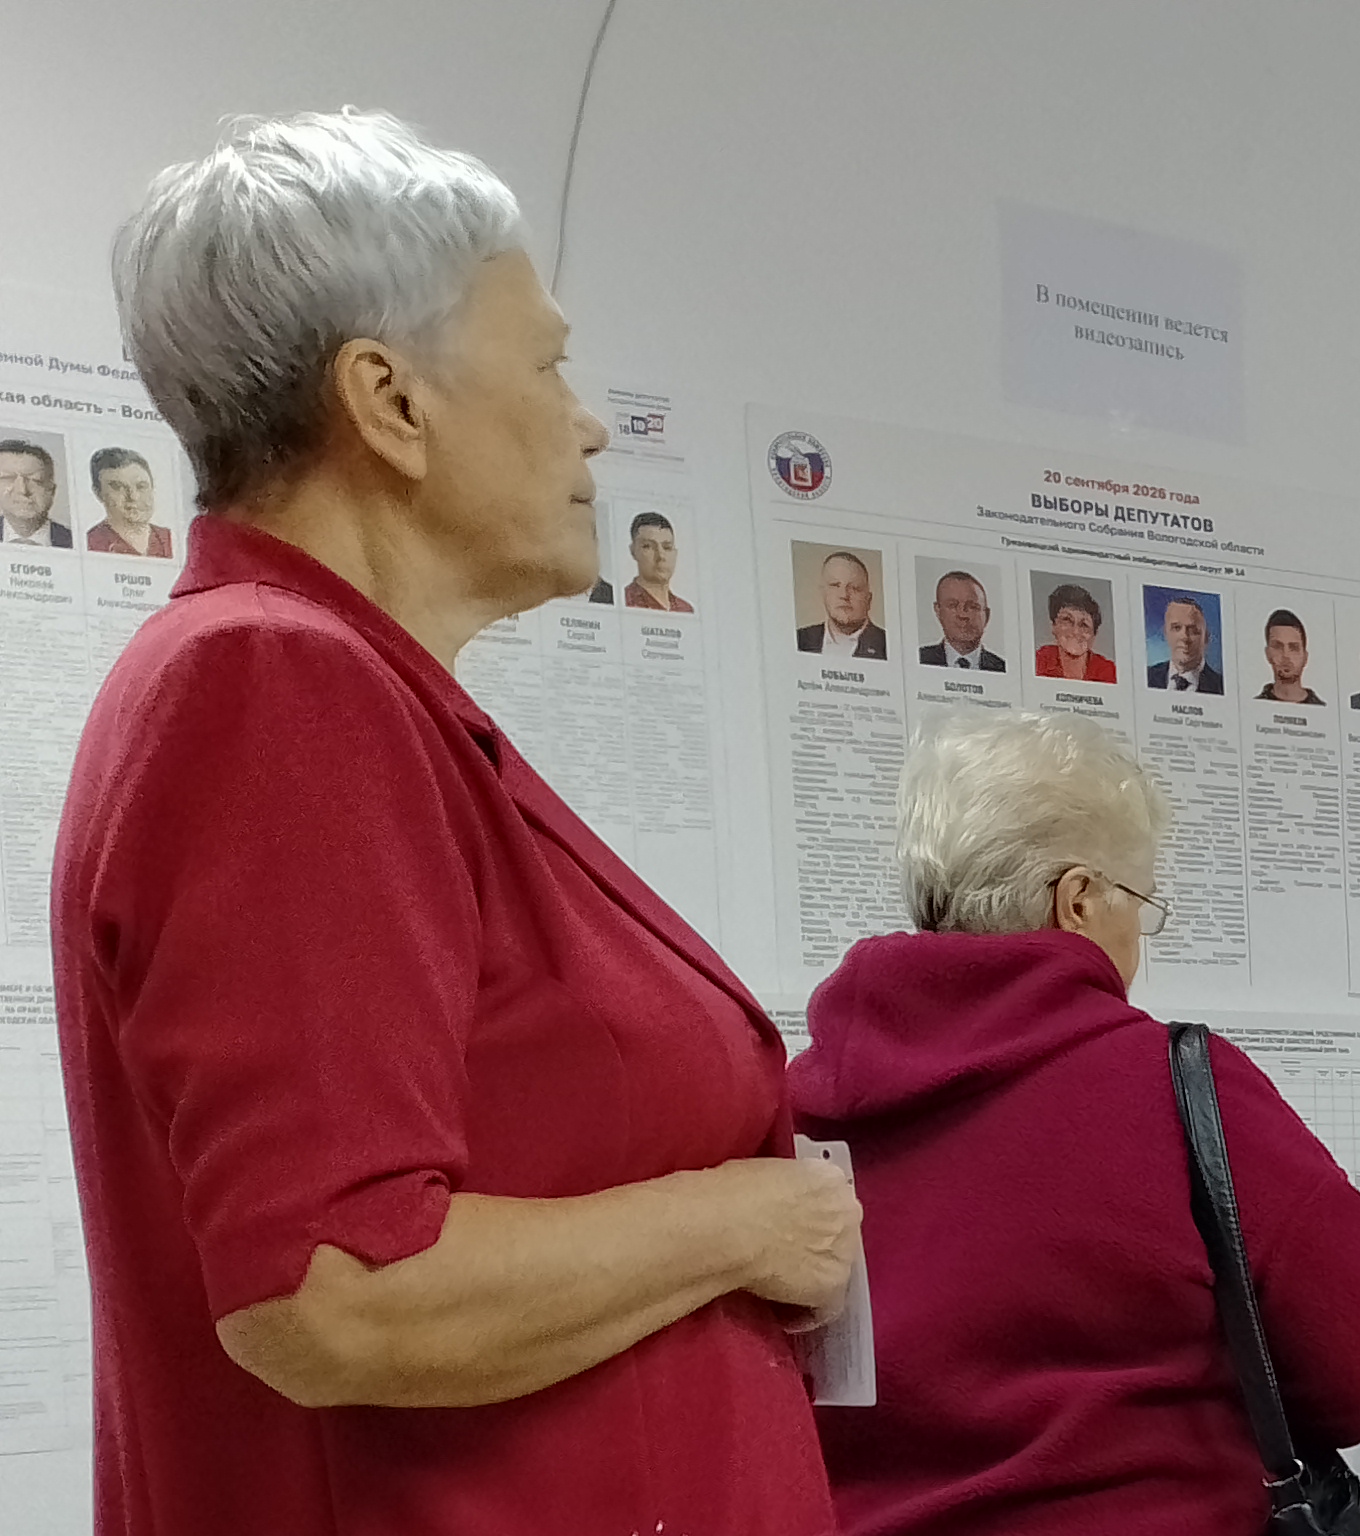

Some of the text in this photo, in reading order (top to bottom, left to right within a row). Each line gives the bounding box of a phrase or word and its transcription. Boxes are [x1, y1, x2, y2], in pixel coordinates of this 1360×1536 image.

[1036, 283, 1229, 344] В помещении ведется
[1073, 324, 1185, 360] видеозапись
[48, 356, 93, 374] Думы
[30, 394, 103, 415] область
[1043, 469, 1200, 505] 20 сентября 2026 года
[1030, 493, 1214, 533] ВЫБОРЫ ДЕПУТАТОВ
[976, 505, 1265, 556] Законодательного Собрания Вологодской области
[10, 563, 52, 577] ЕГОРОВ
[114, 573, 152, 586] ЕРШОВ
[944, 681, 984, 695] БОЛОТОВ
